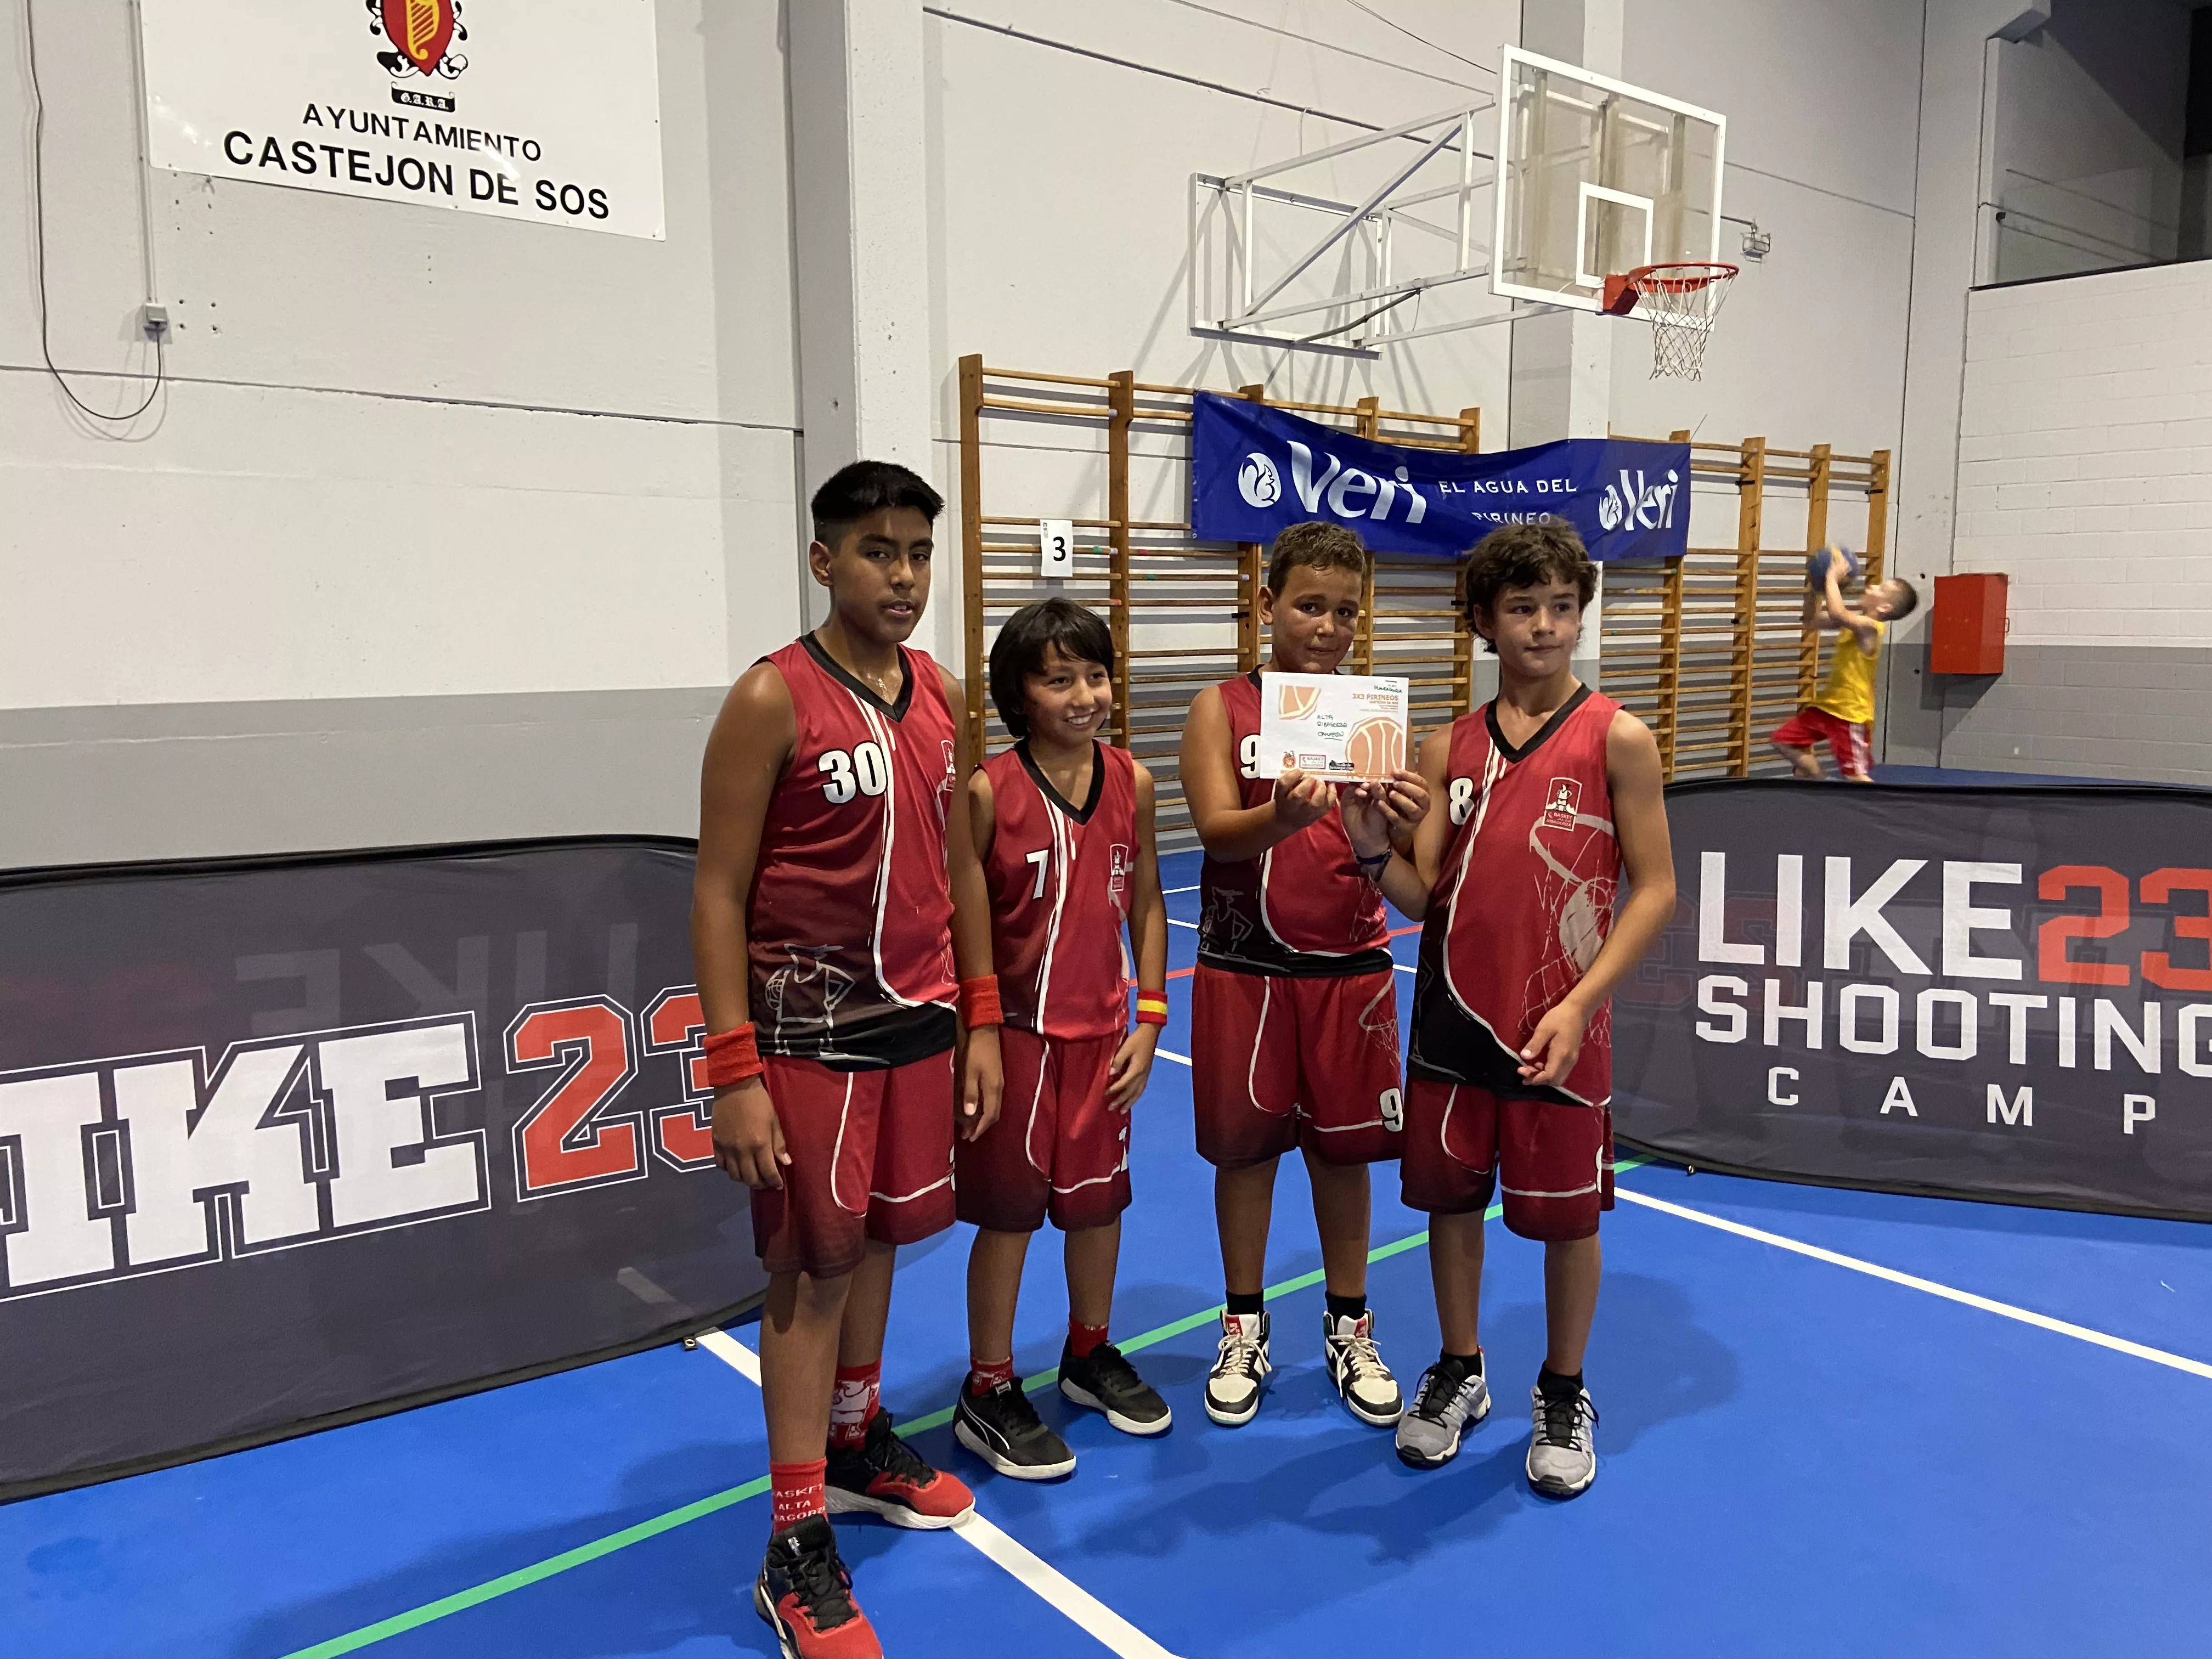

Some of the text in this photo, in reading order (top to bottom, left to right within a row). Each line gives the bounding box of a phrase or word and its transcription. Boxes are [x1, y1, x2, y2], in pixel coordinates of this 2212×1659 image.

[302, 103, 541, 161] AYUNTAMIENTO
[223, 130, 609, 219] CASTEJON DE SOS
[1287, 440, 1427, 524] Veri
[1438, 478, 1577, 494] EL AGUA DEL
[1620, 469, 1678, 531] Veri
[1053, 536, 1066, 562] 3
[818, 741, 888, 805] 30
[1239, 733, 1261, 779] 9
[1449, 777, 1475, 826] 8
[1026, 849, 1050, 900] 7
[1379, 1087, 1404, 1133] 9
[779, 1499, 811, 1510] ALTA
